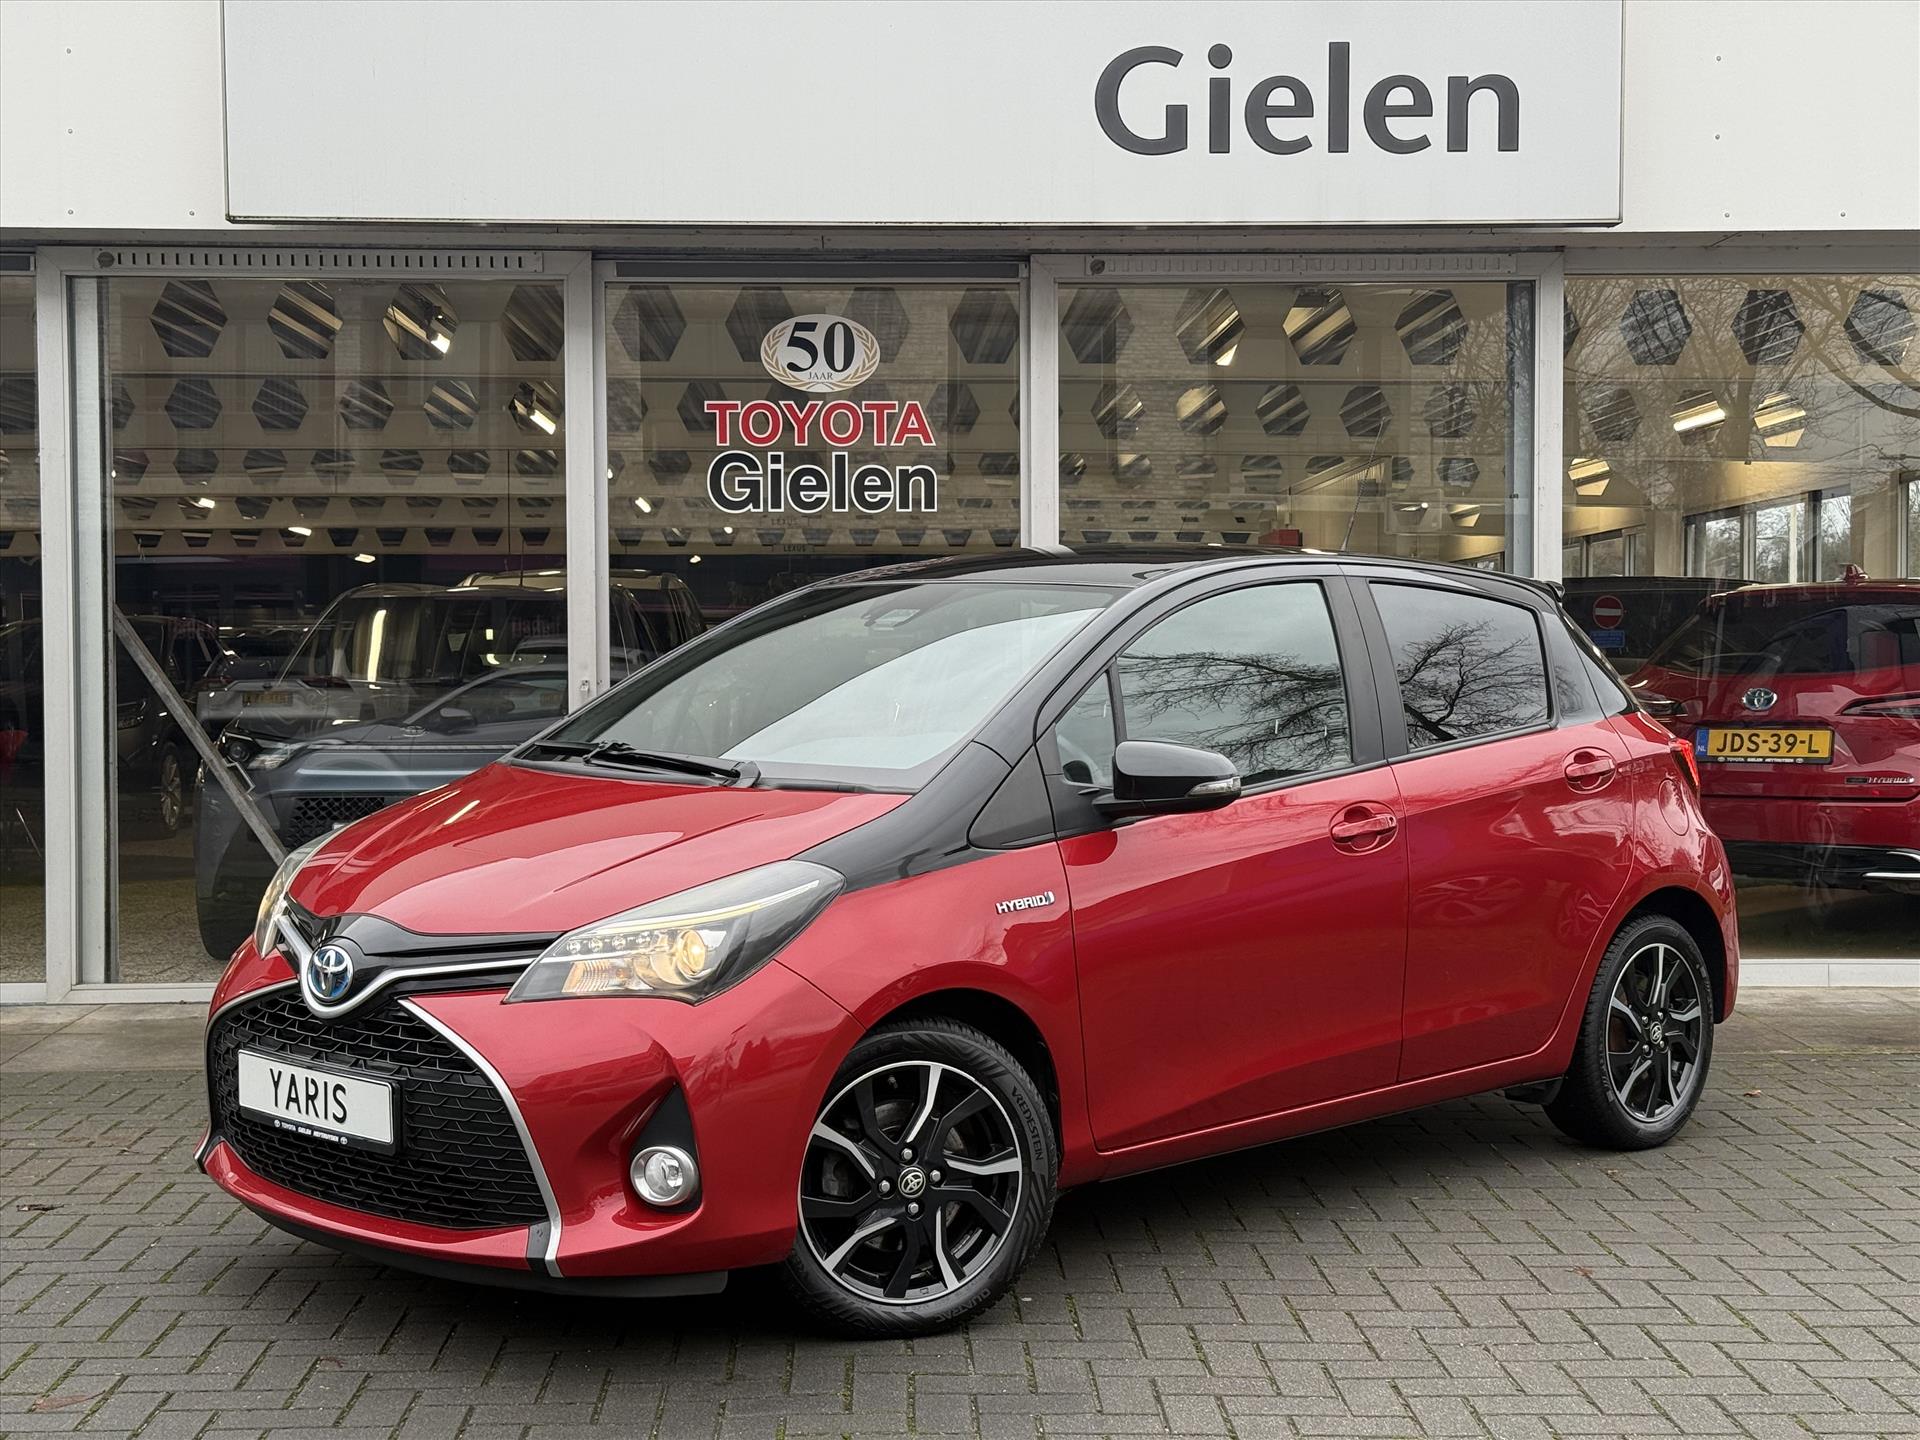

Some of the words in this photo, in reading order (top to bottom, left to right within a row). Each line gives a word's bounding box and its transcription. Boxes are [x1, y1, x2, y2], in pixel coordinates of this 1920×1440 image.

[1095, 42, 1519, 155] Gielen
[787, 321, 855, 373] 50
[808, 371, 833, 380] JAAR
[704, 400, 936, 446] TOYOTA
[707, 450, 938, 514] Gielen
[1716, 732, 1820, 754] JDS-39-L
[995, 894, 1048, 914] HYBRID
[269, 1068, 347, 1124] YARIS
[1011, 1086, 1044, 1161] VREDESTEIN
